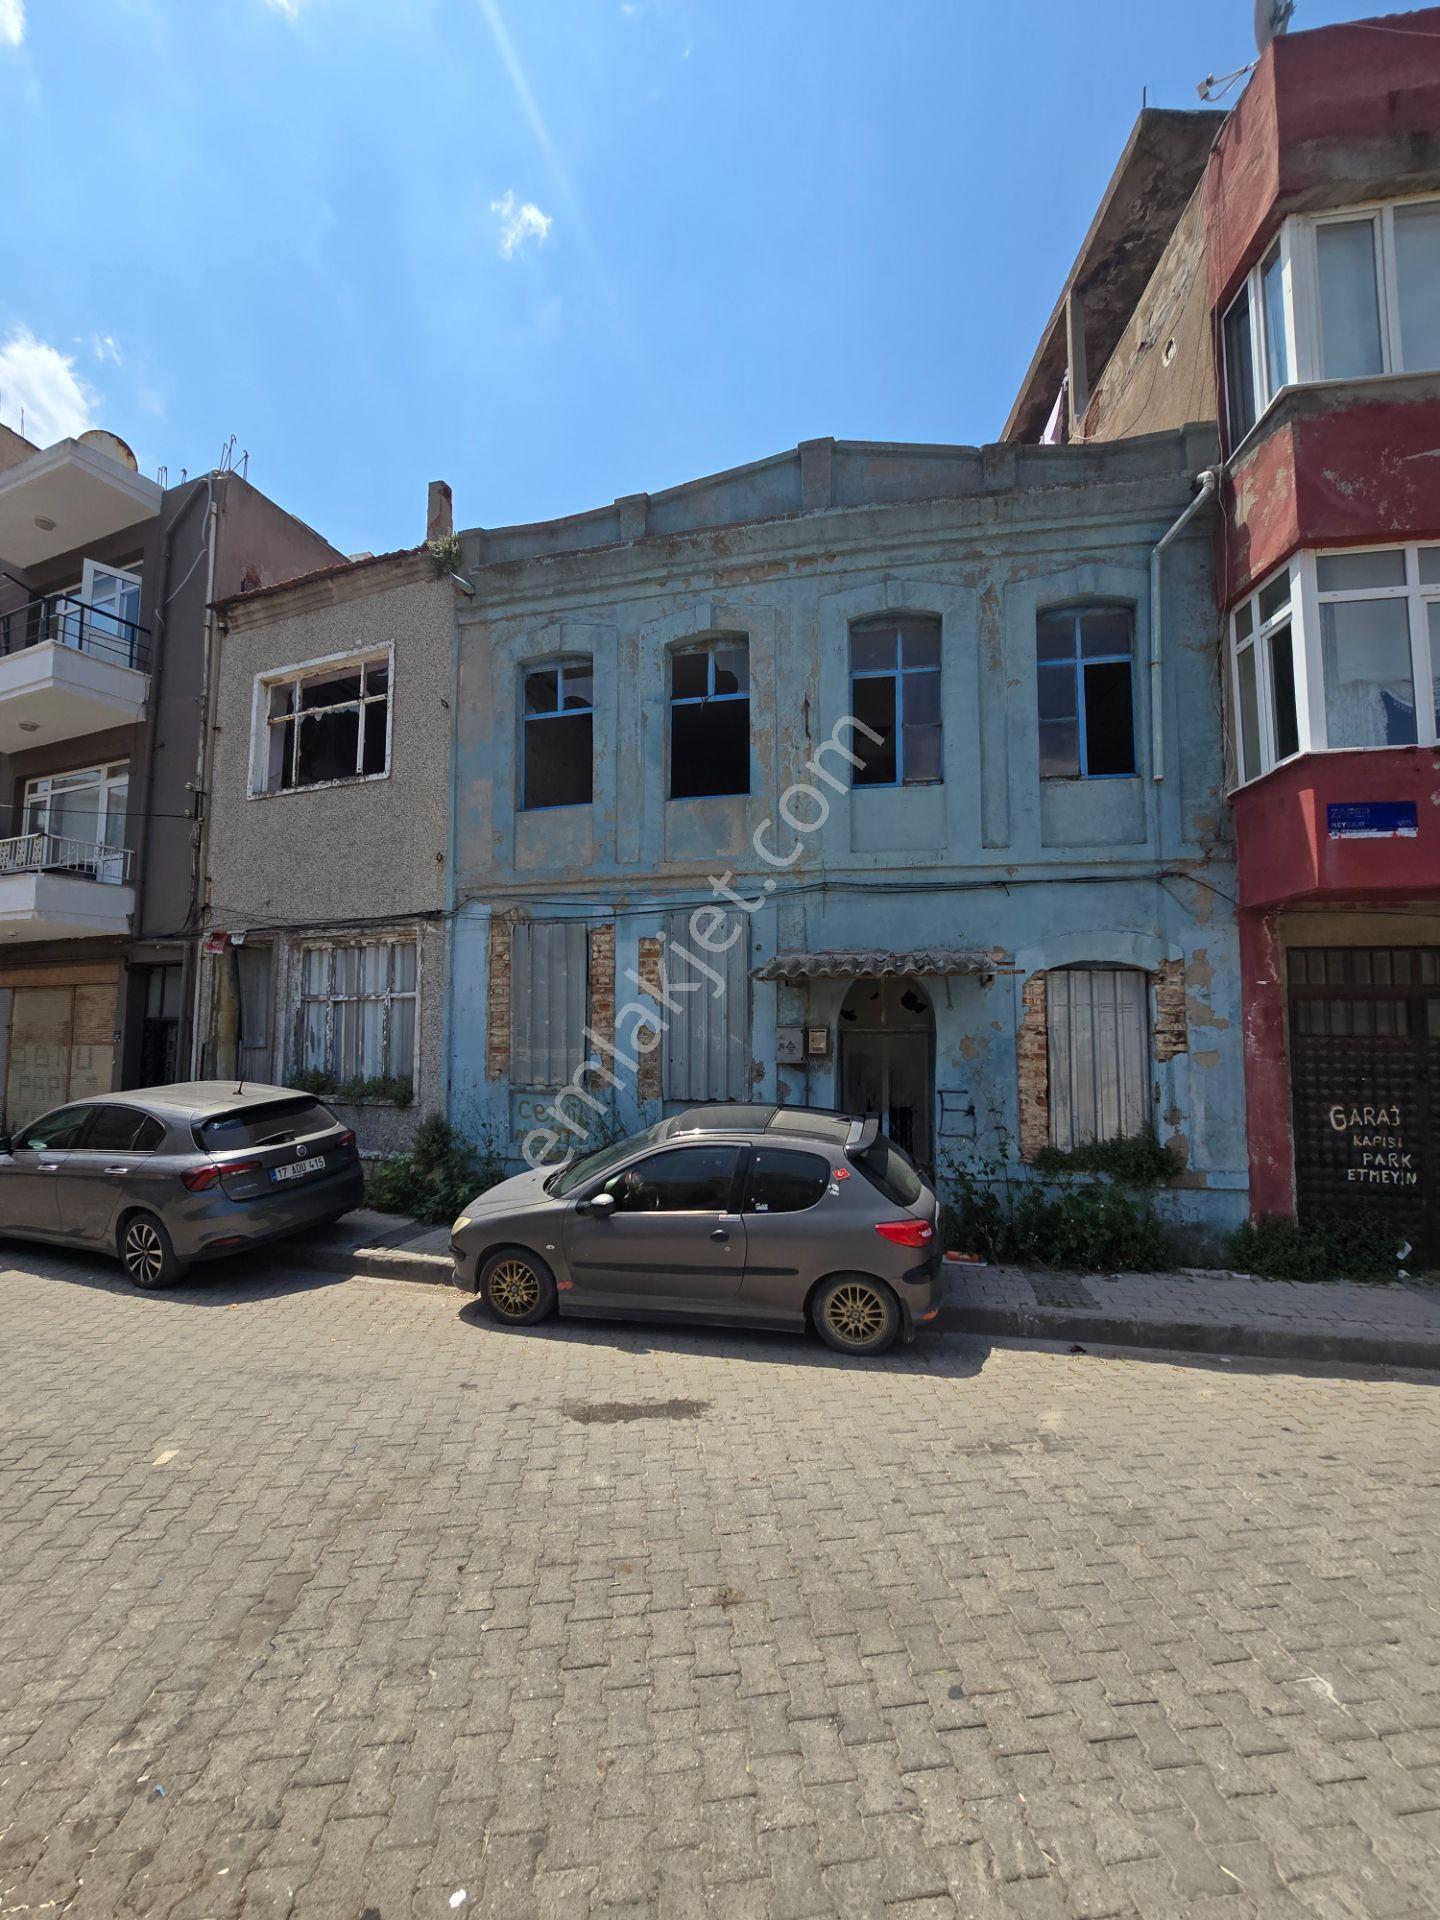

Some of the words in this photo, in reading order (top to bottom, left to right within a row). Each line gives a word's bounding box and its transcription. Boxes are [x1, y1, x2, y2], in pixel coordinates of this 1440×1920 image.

[1329, 1105, 1400, 1131] GARAJ
[1353, 1135, 1403, 1149] KAPISI
[278, 1167, 287, 1179] 17
[309, 1157, 324, 1169] 415
[1363, 1152, 1412, 1168] PARK
